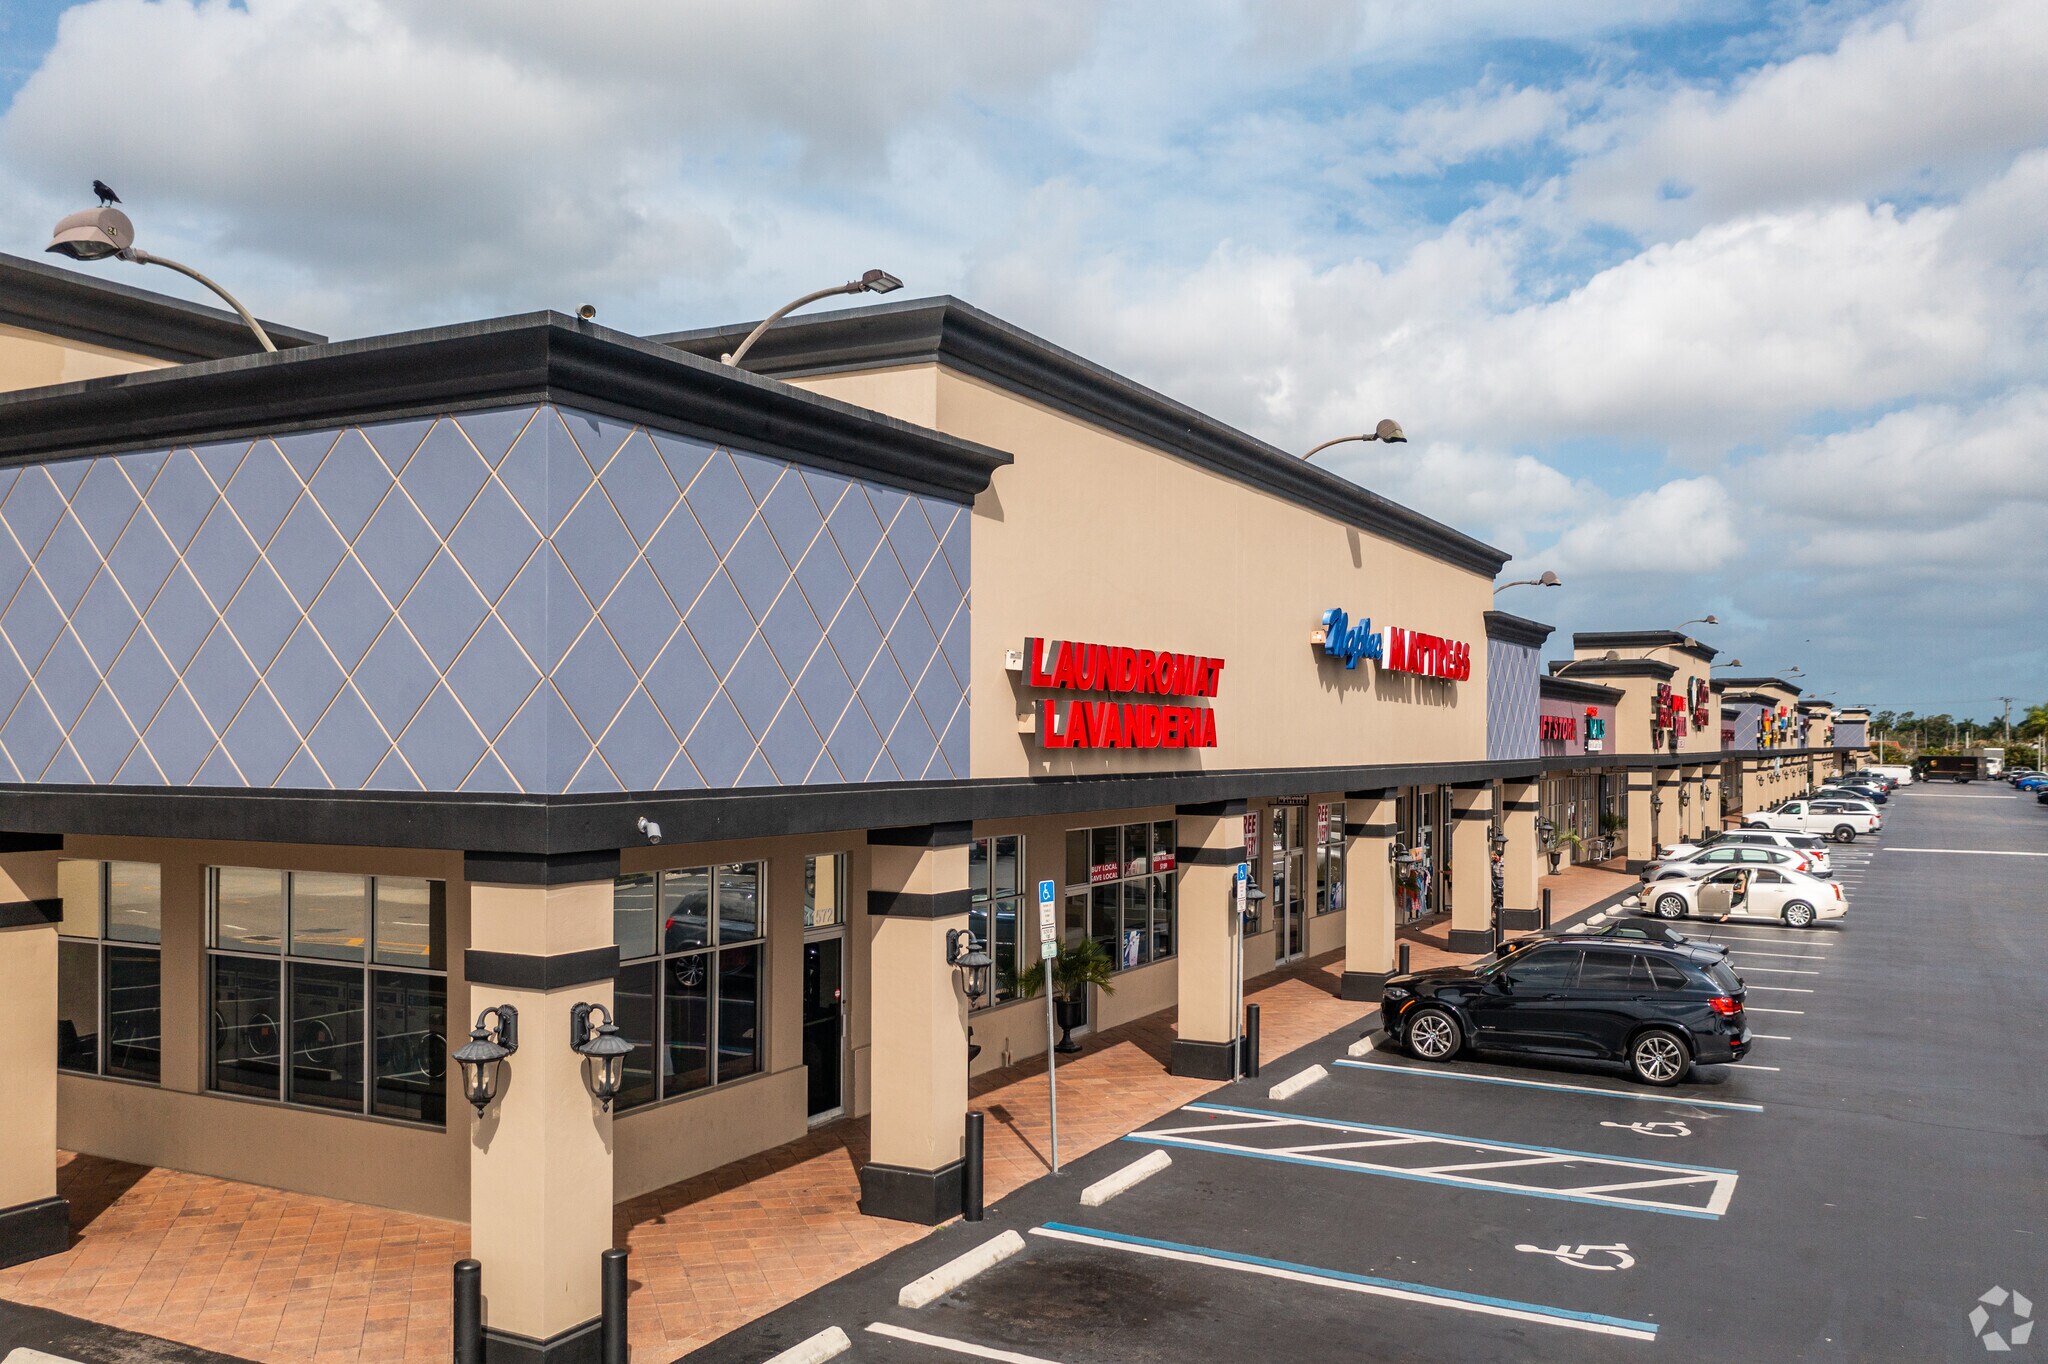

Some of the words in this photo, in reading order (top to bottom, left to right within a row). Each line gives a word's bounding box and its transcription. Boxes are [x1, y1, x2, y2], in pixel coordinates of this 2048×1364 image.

[1322, 607, 1383, 669] Naples
[1387, 626, 1470, 681] MATTRESS
[1026, 637, 1225, 698] LAUNDROMAT
[1038, 699, 1218, 749] LAVANDERIA
[1553, 716, 1577, 741] STORE
[1102, 863, 1118, 871] LOCAL
[1103, 872, 1118, 880] LOCAL
